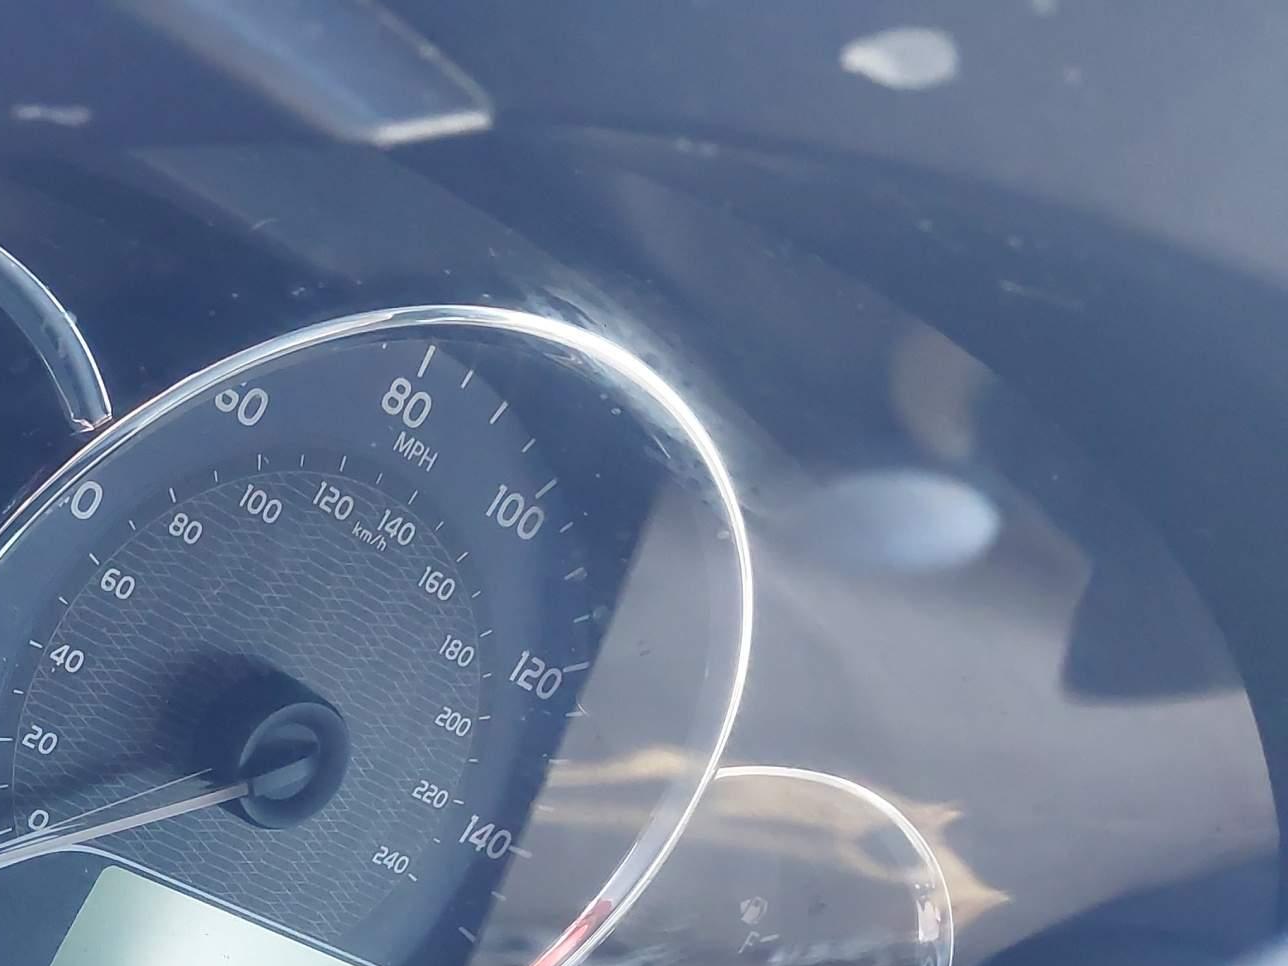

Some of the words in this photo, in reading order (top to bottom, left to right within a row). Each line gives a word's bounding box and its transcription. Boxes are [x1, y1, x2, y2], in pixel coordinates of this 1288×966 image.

[381, 376, 433, 429] 80
[392, 431, 439, 472] MPH
[58, 481, 103, 520] 0
[239, 483, 283, 524] 100
[312, 480, 355, 521] 120
[485, 484, 545, 541] 100
[168, 512, 203, 545] 80
[351, 521, 387, 552] km/h
[376, 508, 416, 546] 140
[100, 568, 136, 600] 60
[418, 566, 455, 601] 160
[49, 644, 85, 673] 40
[439, 634, 474, 667] 180
[509, 650, 562, 700] 120
[434, 706, 471, 737] 200
[21, 724, 58, 755] 20
[411, 779, 449, 809] 220
[27, 809, 50, 831] 0
[459, 814, 513, 859] 140
[371, 846, 410, 875] 240
